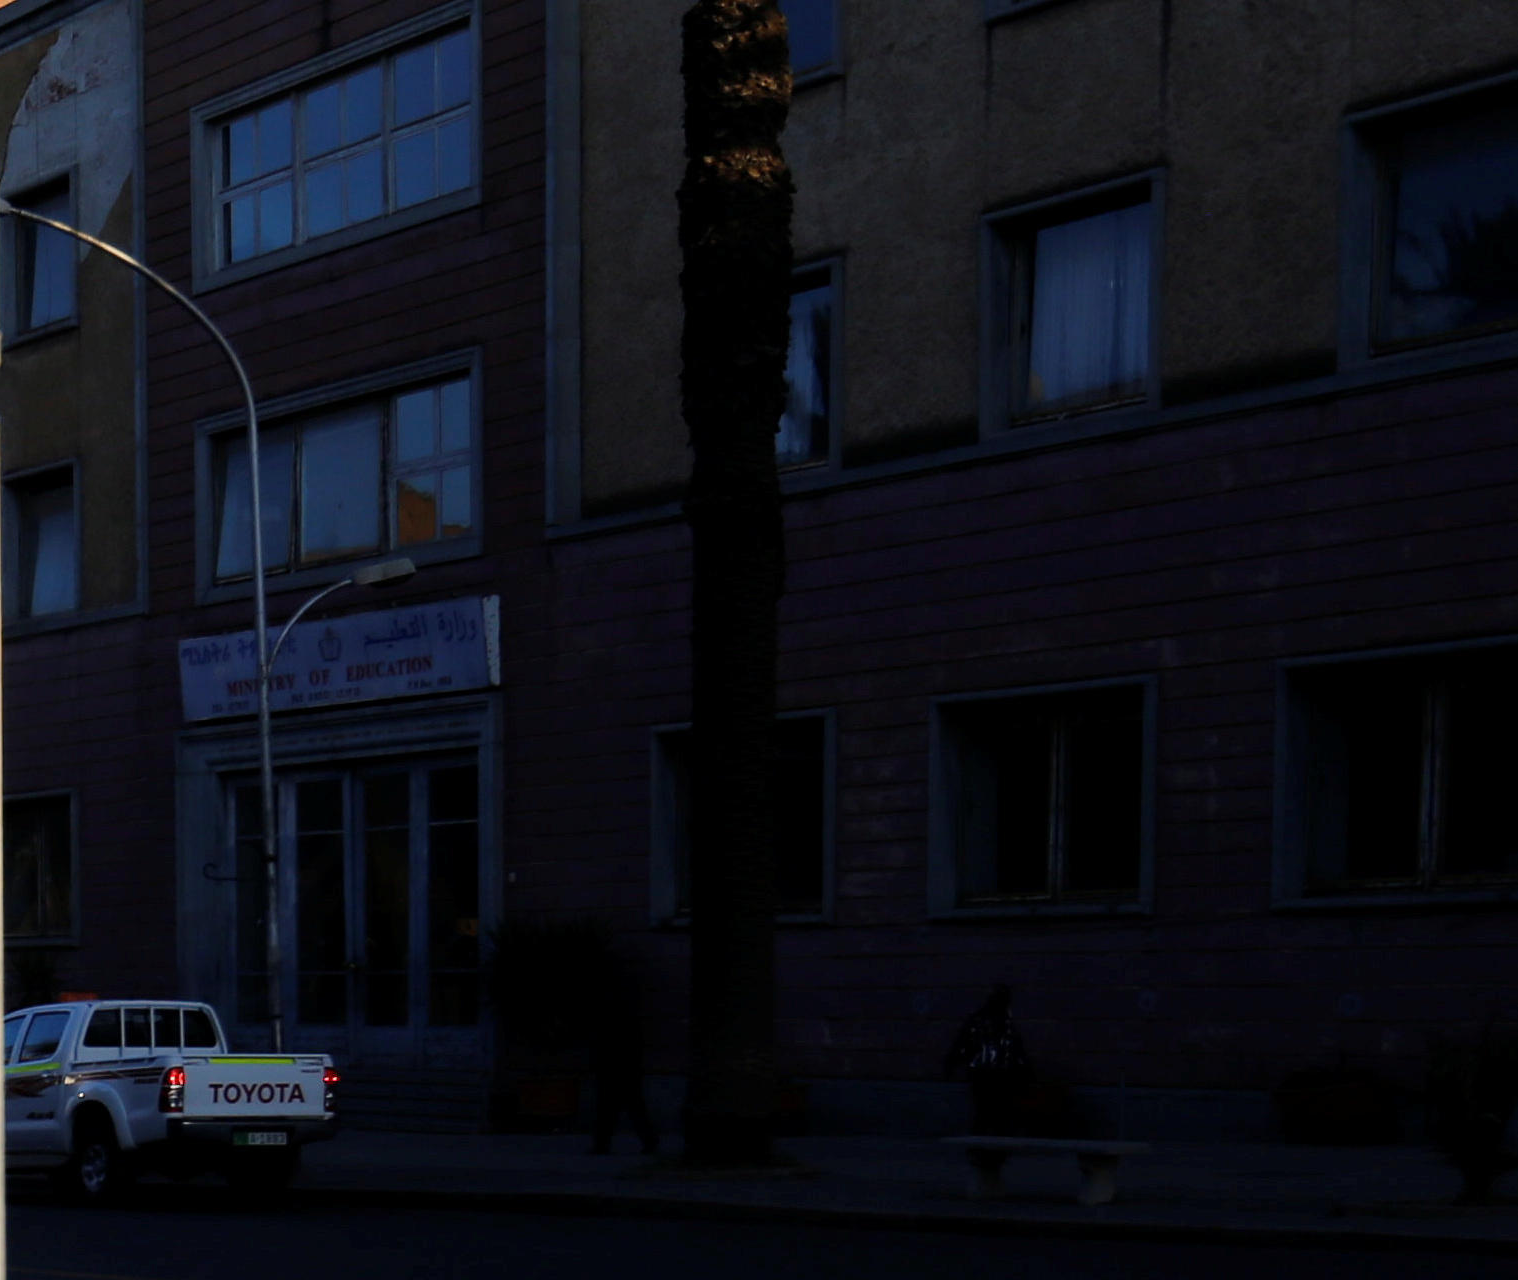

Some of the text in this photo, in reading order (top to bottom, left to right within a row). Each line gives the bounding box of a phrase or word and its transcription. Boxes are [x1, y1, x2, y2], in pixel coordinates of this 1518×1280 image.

[226, 673, 296, 696] MINITRY
[309, 668, 331, 686] OF
[347, 656, 432, 682] EDUCATION
[209, 1083, 305, 1104] TOYOTA
